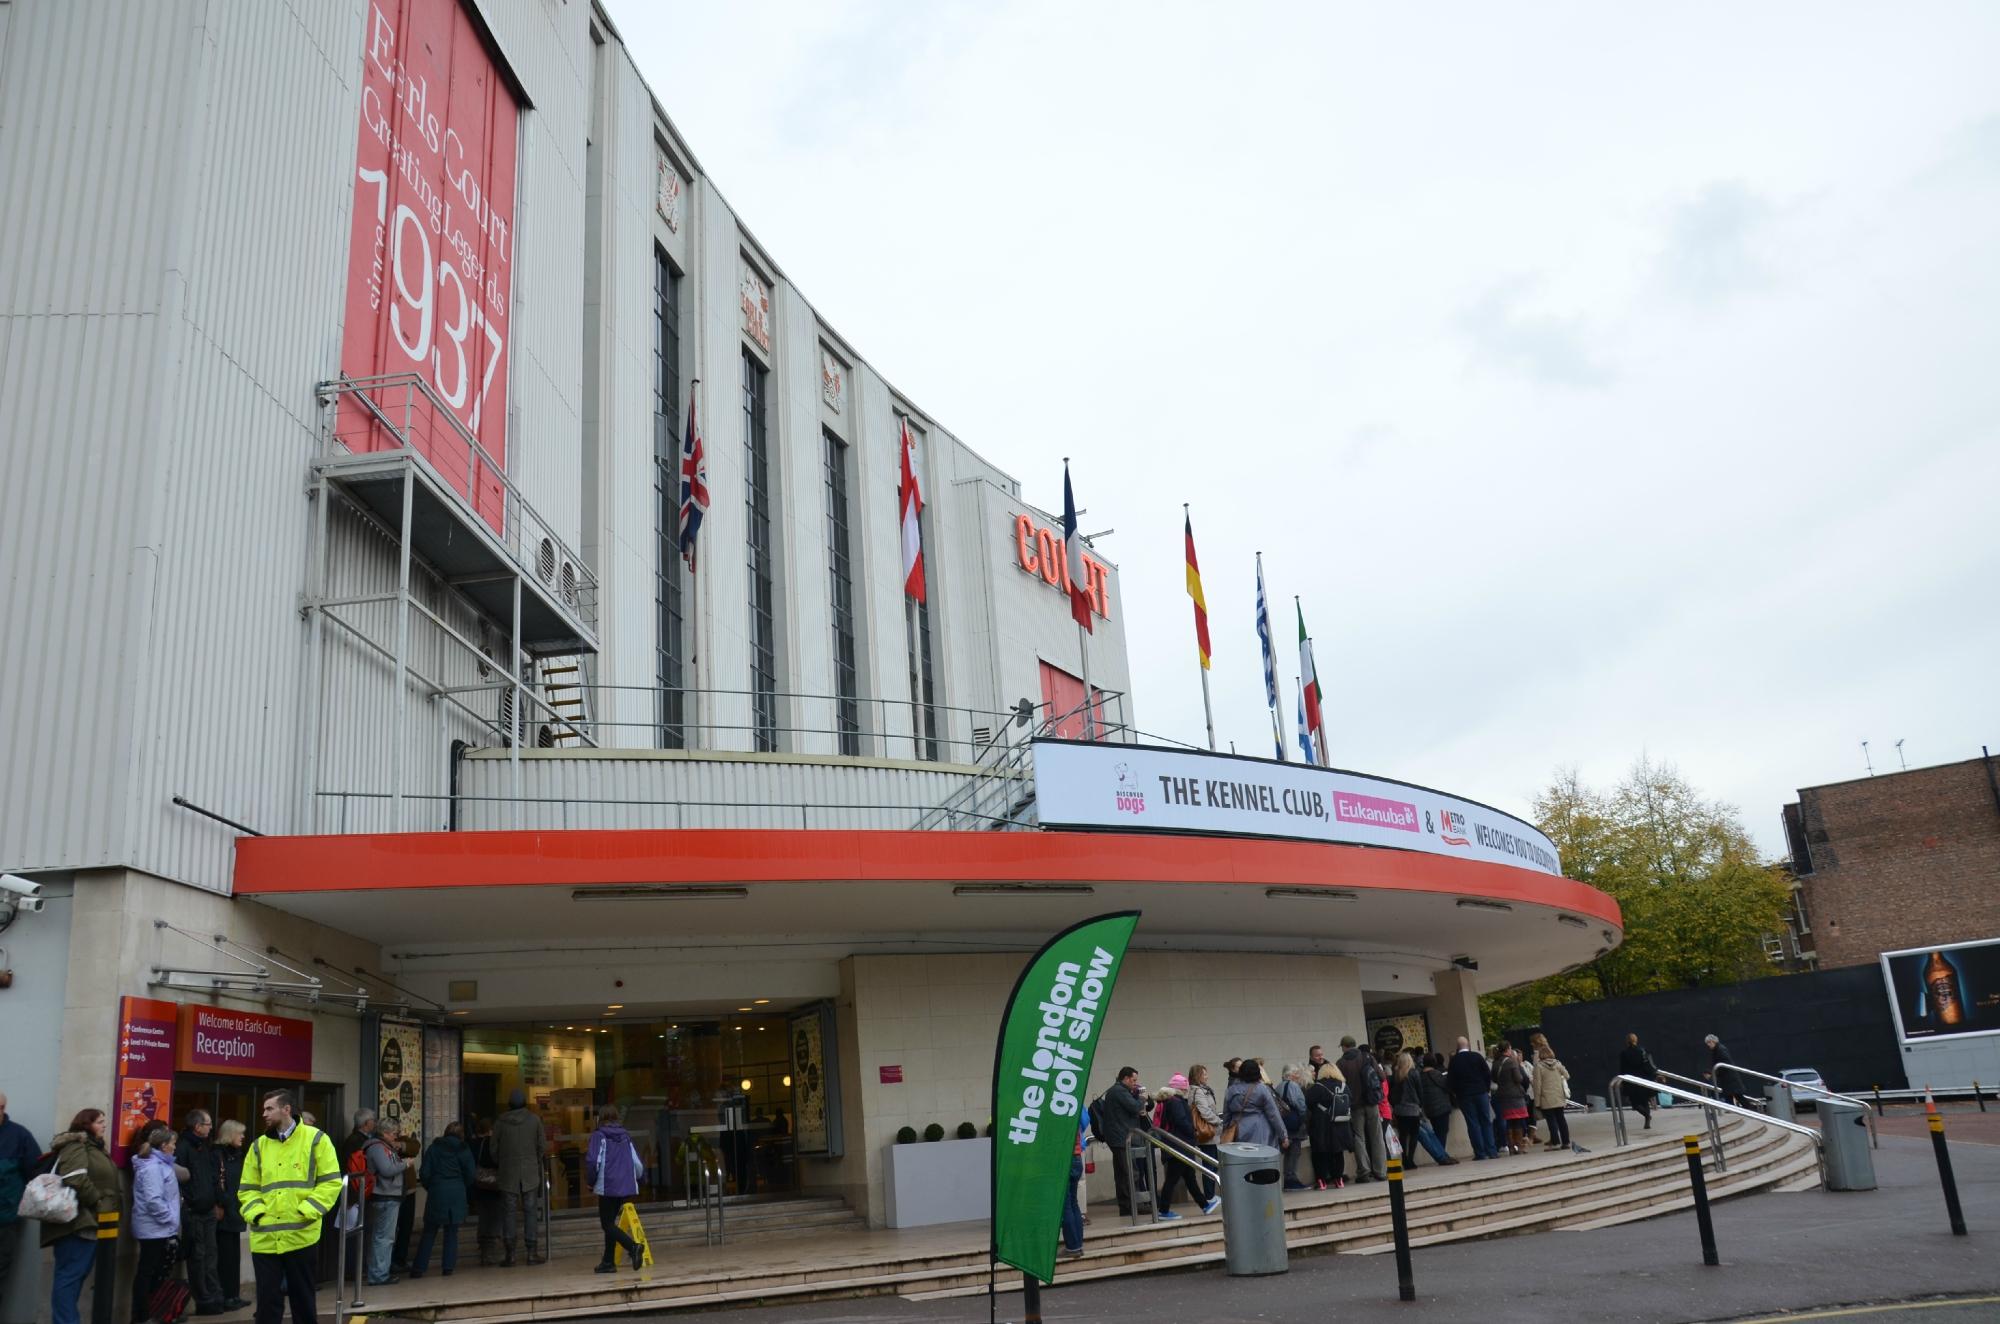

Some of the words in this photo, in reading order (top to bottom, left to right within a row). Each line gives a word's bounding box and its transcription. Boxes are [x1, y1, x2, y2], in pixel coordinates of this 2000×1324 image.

[443, 127, 508, 262] Court
[358, 165, 503, 435] 1937
[1158, 775, 1202, 807] THE
[1206, 779, 1281, 814] KENNEL
[1282, 787, 1329, 823] CLUB,
[1338, 799, 1406, 827] Eukanuba
[1424, 809, 1436, 835] &
[1474, 823, 1514, 855] WELCOMES
[1514, 837, 1528, 859] YOU
[198, 1011, 235, 1030] Welcome
[235, 1018, 244, 1031] to
[244, 1018, 263, 1034] Earls
[263, 1021, 282, 1037] Court
[1020, 961, 1082, 1082] london
[1065, 945, 1115, 1042] show
[196, 1031, 256, 1061] Reception
[1049, 1041, 1085, 1117] golf
[1008, 1085, 1046, 1145] the
